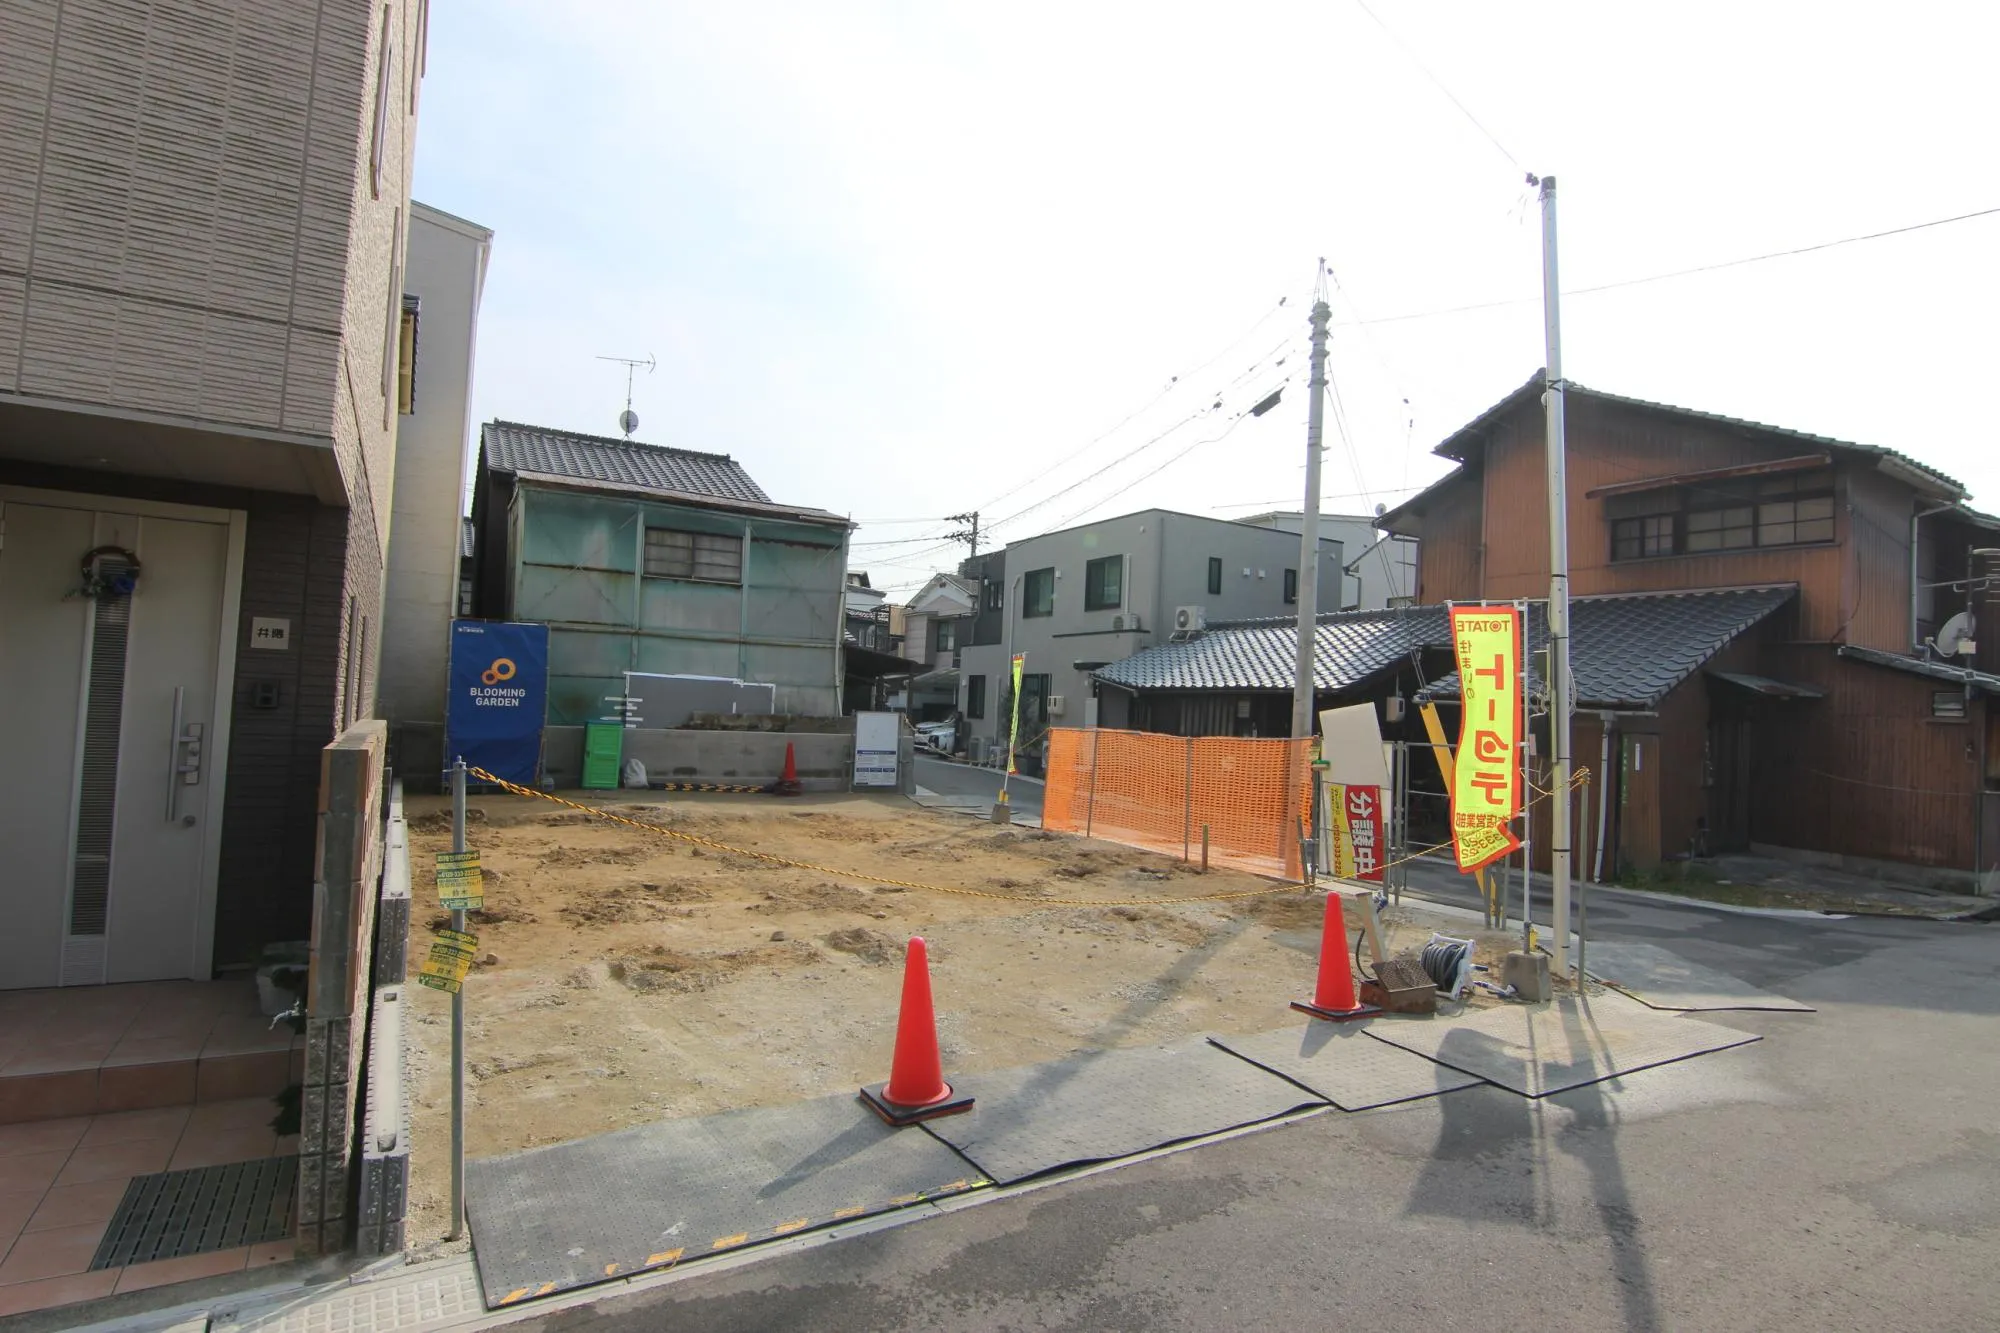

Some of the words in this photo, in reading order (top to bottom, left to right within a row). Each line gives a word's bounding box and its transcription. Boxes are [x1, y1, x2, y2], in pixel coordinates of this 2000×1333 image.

[470, 687, 526, 697] BLOOMING
[475, 697, 519, 706] GARDEN
[1349, 791, 1376, 874] 分譲中
